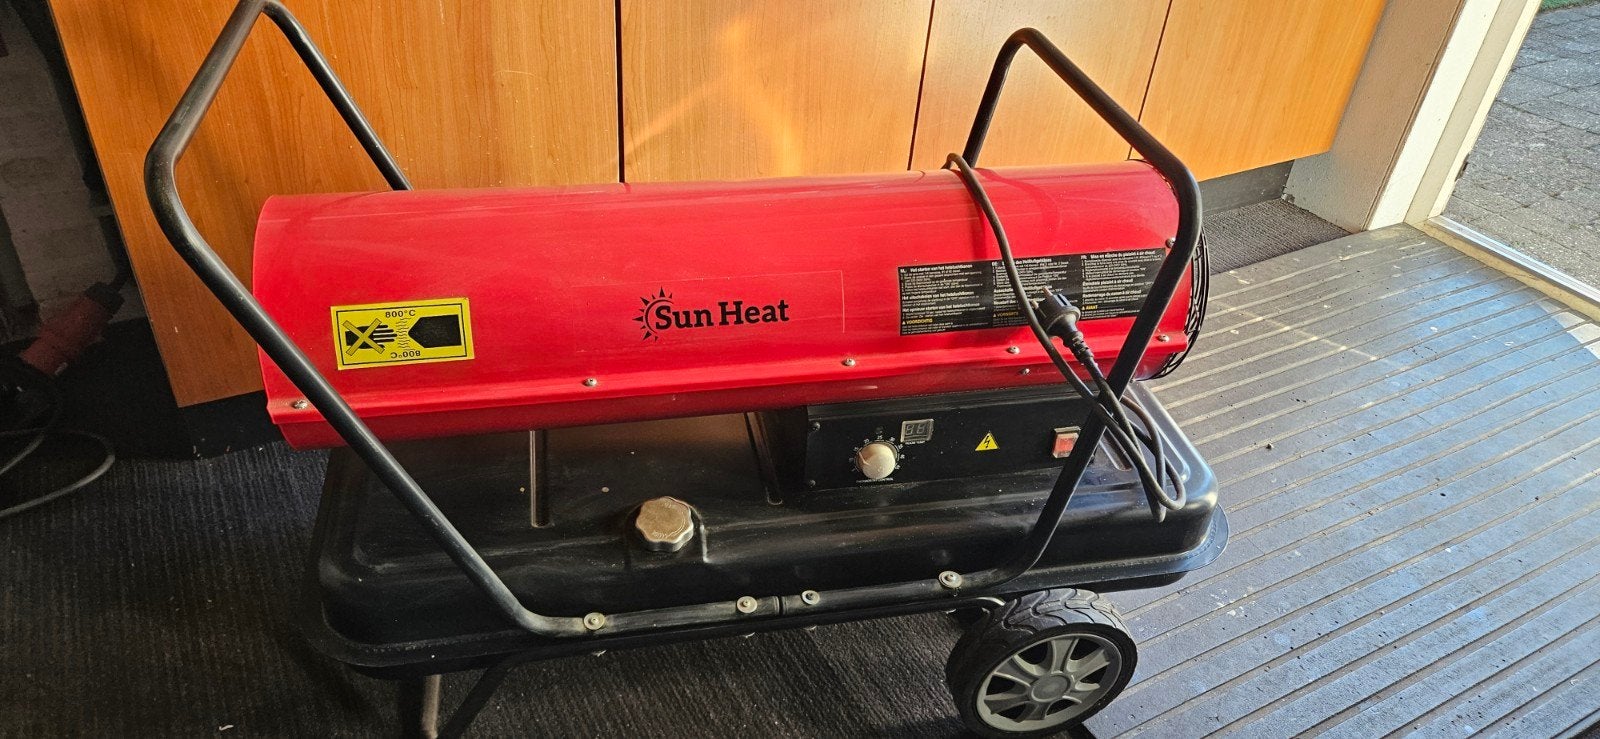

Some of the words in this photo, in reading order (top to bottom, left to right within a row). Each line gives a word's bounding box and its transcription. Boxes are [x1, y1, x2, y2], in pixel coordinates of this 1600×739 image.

[385, 310, 416, 318] 800°C
[655, 305, 714, 330] Sun
[718, 300, 789, 326] Heat
